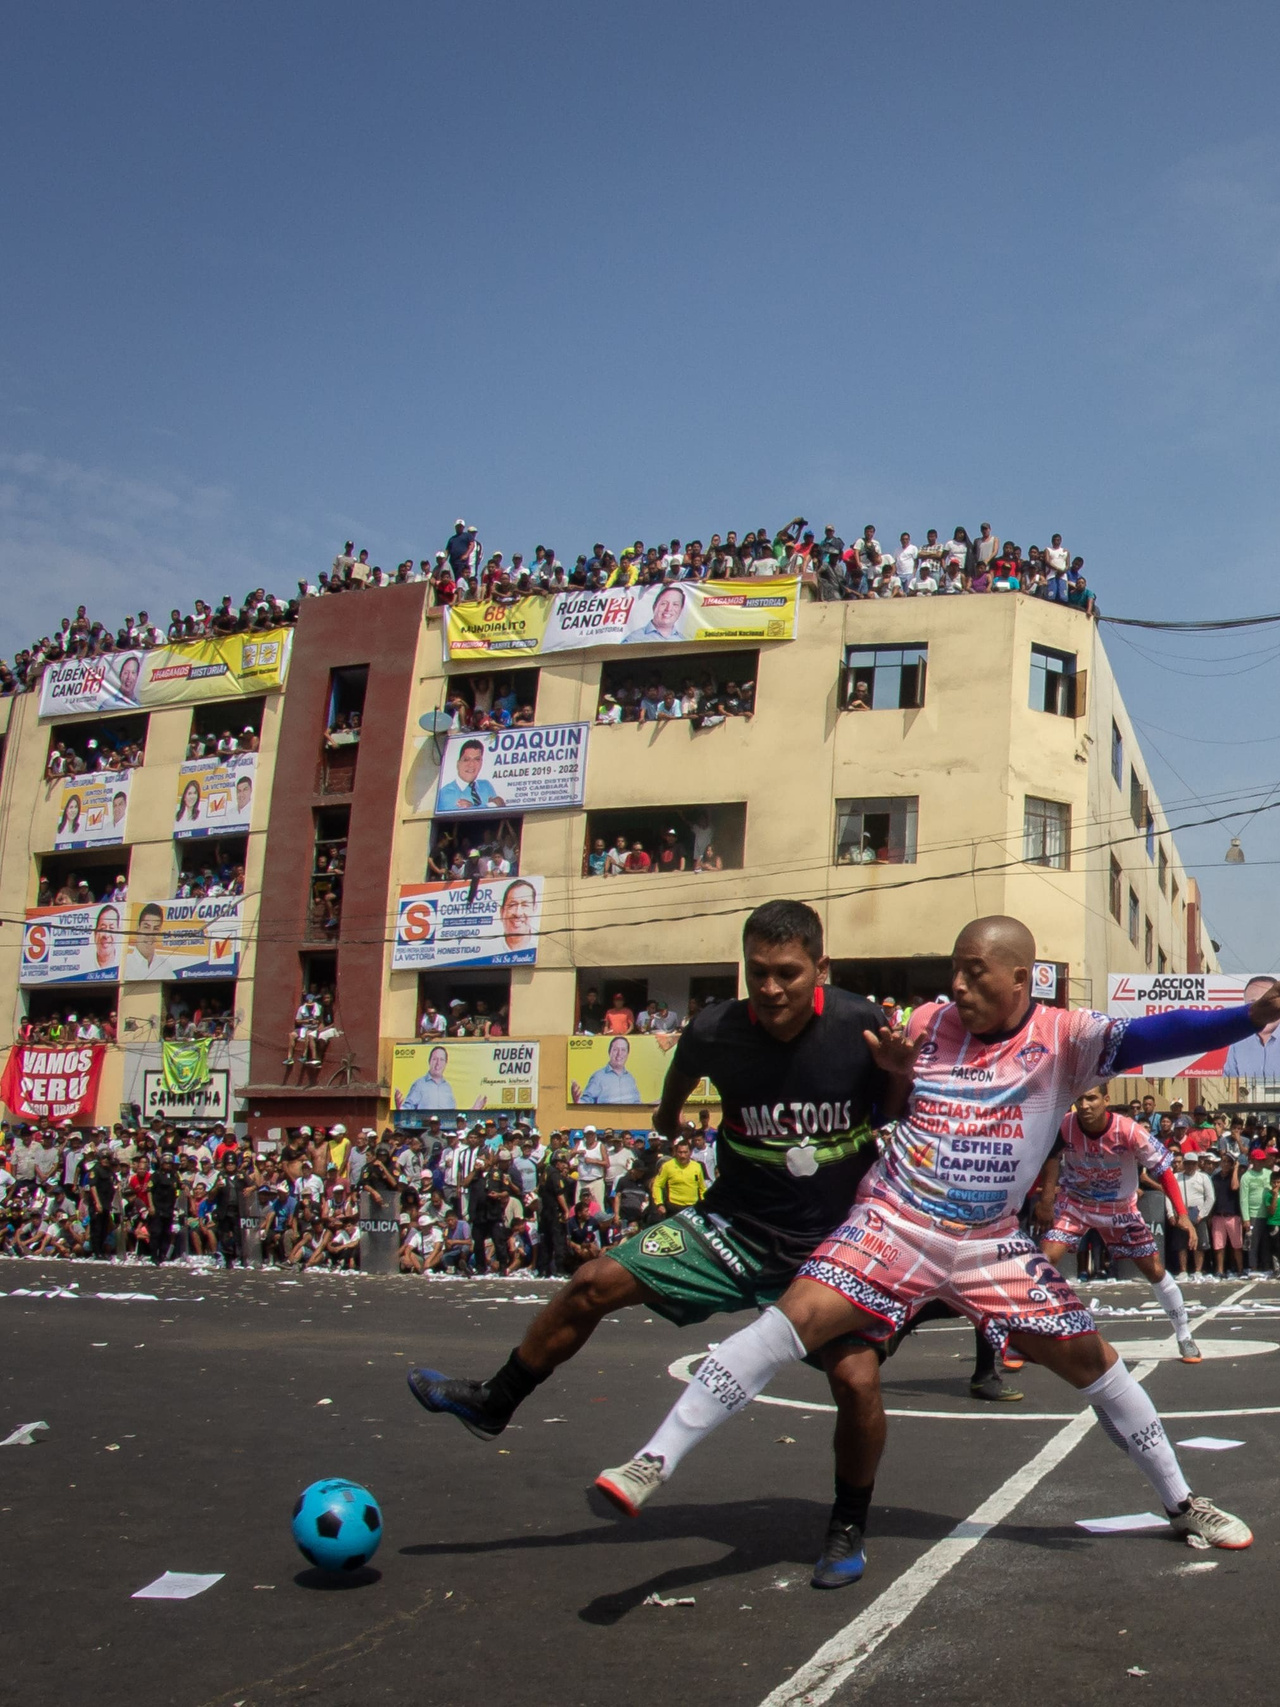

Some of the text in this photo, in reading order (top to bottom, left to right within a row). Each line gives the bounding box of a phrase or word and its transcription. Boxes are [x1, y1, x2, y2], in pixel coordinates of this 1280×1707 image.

[556, 596, 608, 615] RUBÉN
[610, 597, 631, 610] 20
[484, 605, 506, 622] 68
[561, 614, 603, 630] CANO
[50, 664, 85, 684] RUBÉN
[52, 683, 82, 698] CANO
[489, 727, 582, 752] JOAQUIN
[494, 747, 579, 766] ALBARRACIN
[492, 767, 530, 779] ALCALDE
[532, 766, 551, 776] 2019
[559, 764, 579, 774] 2022
[166, 901, 238, 920] RUDY GARCÍA
[440, 902, 498, 916] CONTRERAS
[59, 913, 90, 924] VICTOR
[404, 904, 431, 942] S
[440, 929, 480, 938] SEGURIDAD
[28, 925, 46, 960] S
[437, 946, 481, 955] HONESTIDAD
[405, 953, 435, 961] VICTORIA
[1152, 978, 1205, 990] ACCION
[1137, 989, 1206, 1001] POPULAR
[493, 1044, 534, 1061] RUBÉN
[22, 1049, 93, 1075] VAMOS
[498, 1061, 531, 1075] CANO
[950, 1066, 994, 1083] FALCON
[20, 1073, 89, 1102] PERÚ
[149, 1090, 221, 1107] SAMANTHA
[741, 1100, 852, 1136] MAC TOOLS
[975, 1105, 1024, 1121] MAMA
[954, 1121, 1025, 1139] ARANDA
[951, 1140, 1013, 1156] ESTHER
[940, 1156, 1021, 1173] CAPUÑAY
[953, 1174, 967, 1182] VA
[969, 1175, 990, 1184] POR
[993, 1175, 1016, 1184] LIMA
[708, 1358, 747, 1400] PURITO
